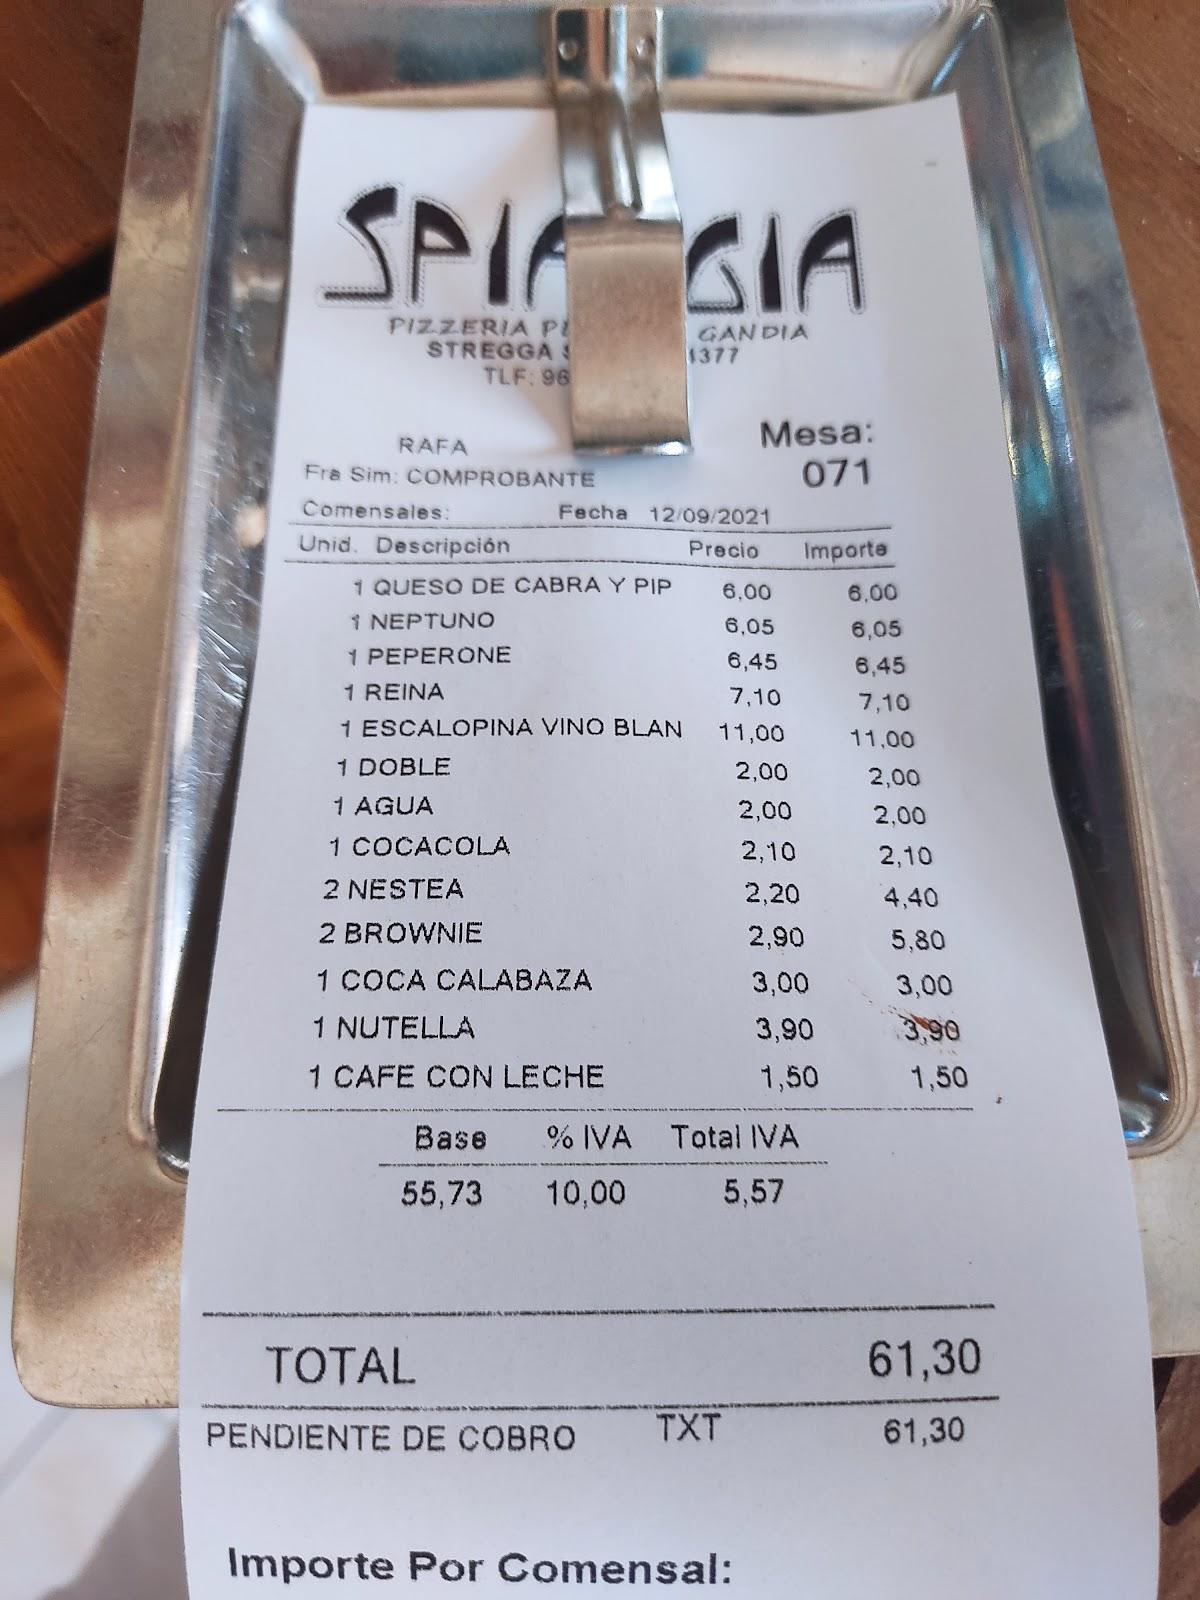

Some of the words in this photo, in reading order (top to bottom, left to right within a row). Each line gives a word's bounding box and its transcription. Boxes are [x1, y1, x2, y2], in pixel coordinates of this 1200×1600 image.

[318, 180, 866, 316] SPIAGIA
[388, 316, 528, 340] PIZZERIA
[698, 322, 810, 344] GANDIA
[427, 342, 554, 362] STREGGA
[399, 436, 468, 456] RAFA
[760, 419, 873, 449] Mesa:
[305, 463, 341, 482] Fra
[349, 466, 398, 485] Sim:
[406, 468, 595, 489] COMPROBANTE
[802, 457, 870, 489] 071
[302, 500, 449, 521] Comensales:
[558, 503, 628, 521] Fecha
[649, 506, 770, 526] 12/09/2021
[376, 535, 508, 560] Descripción
[689, 539, 759, 560] Precio
[804, 541, 888, 566] Importe
[353, 579, 363, 596] 1
[373, 577, 464, 597] QUESO
[471, 577, 506, 595] DE
[514, 576, 601, 594] CABRA
[608, 576, 626, 594] Y
[634, 577, 672, 596] PIP
[722, 582, 772, 602] 6,00
[847, 583, 899, 603] 6,00
[351, 613, 360, 631] 1
[370, 611, 495, 631] NEPTUNO
[724, 616, 775, 636] 6,05
[851, 619, 902, 641] 6,05
[348, 648, 357, 667] 1
[368, 645, 512, 666] PEPERONE
[727, 651, 778, 673] 6,45
[855, 655, 906, 678] 6,45
[343, 683, 354, 702] 1
[365, 682, 445, 702] REINA
[729, 686, 781, 707] 7,10
[858, 692, 911, 714] 7,10
[340, 719, 351, 738] 1
[362, 718, 534, 738] ESCALOPINA
[541, 717, 605, 737] VINO
[614, 717, 682, 739] BLAN
[719, 722, 785, 745] 11,00
[850, 728, 915, 749] 11,00
[337, 758, 347, 777] 1
[358, 757, 451, 777] DOBLE
[735, 761, 788, 783] 2,00
[868, 766, 921, 789] 2,00
[333, 796, 343, 817] 1
[354, 795, 434, 816] AGUA
[738, 799, 792, 823] 2,00
[873, 804, 927, 826] 2,00
[329, 836, 340, 857] 1
[352, 835, 511, 857] COCACOLA
[741, 839, 796, 864] 2,10
[878, 844, 933, 869] 2,10
[323, 878, 340, 900] 2
[348, 877, 464, 901] NESTEA
[744, 881, 800, 907] 2,20
[883, 886, 939, 910] 4,40
[319, 922, 336, 945] 2
[344, 921, 483, 945] BROWNIE
[748, 924, 805, 951] 2,90
[891, 928, 946, 954] 5,80
[317, 968, 328, 992] 1
[341, 968, 427, 993] COCA
[436, 968, 593, 992] CALABAZA
[751, 970, 809, 998] 3,00
[896, 973, 953, 1000] 3,00
[313, 1015, 324, 1039] 1
[337, 1015, 476, 1040] NUTELLA
[755, 1016, 814, 1044] 3,90
[904, 1018, 961, 1046] 3,90
[309, 1063, 320, 1090] 1
[334, 1063, 415, 1089] CAFE
[426, 1064, 493, 1089] CON
[504, 1063, 605, 1090] LECHE
[760, 1064, 819, 1093] 1,50
[911, 1065, 969, 1093] 1,50
[415, 1124, 487, 1152] Base
[546, 1124, 574, 1150] %
[584, 1124, 633, 1151] IVA
[670, 1123, 741, 1150] Total
[751, 1123, 800, 1150] IVA
[401, 1179, 483, 1210] 55,73
[546, 1179, 626, 1210] 10,00
[723, 1177, 784, 1209] 5,57
[265, 1345, 417, 1386] TOTAL
[868, 1337, 981, 1383] 61,30
[207, 1421, 391, 1452] PENDIENTE
[403, 1424, 446, 1452] DE
[458, 1424, 576, 1453] COBRO
[654, 1412, 722, 1442] TXT
[883, 1415, 965, 1447] 61,30
[228, 1546, 395, 1585] Importe
[409, 1550, 485, 1583] Por
[497, 1552, 731, 1585] Comensal:
